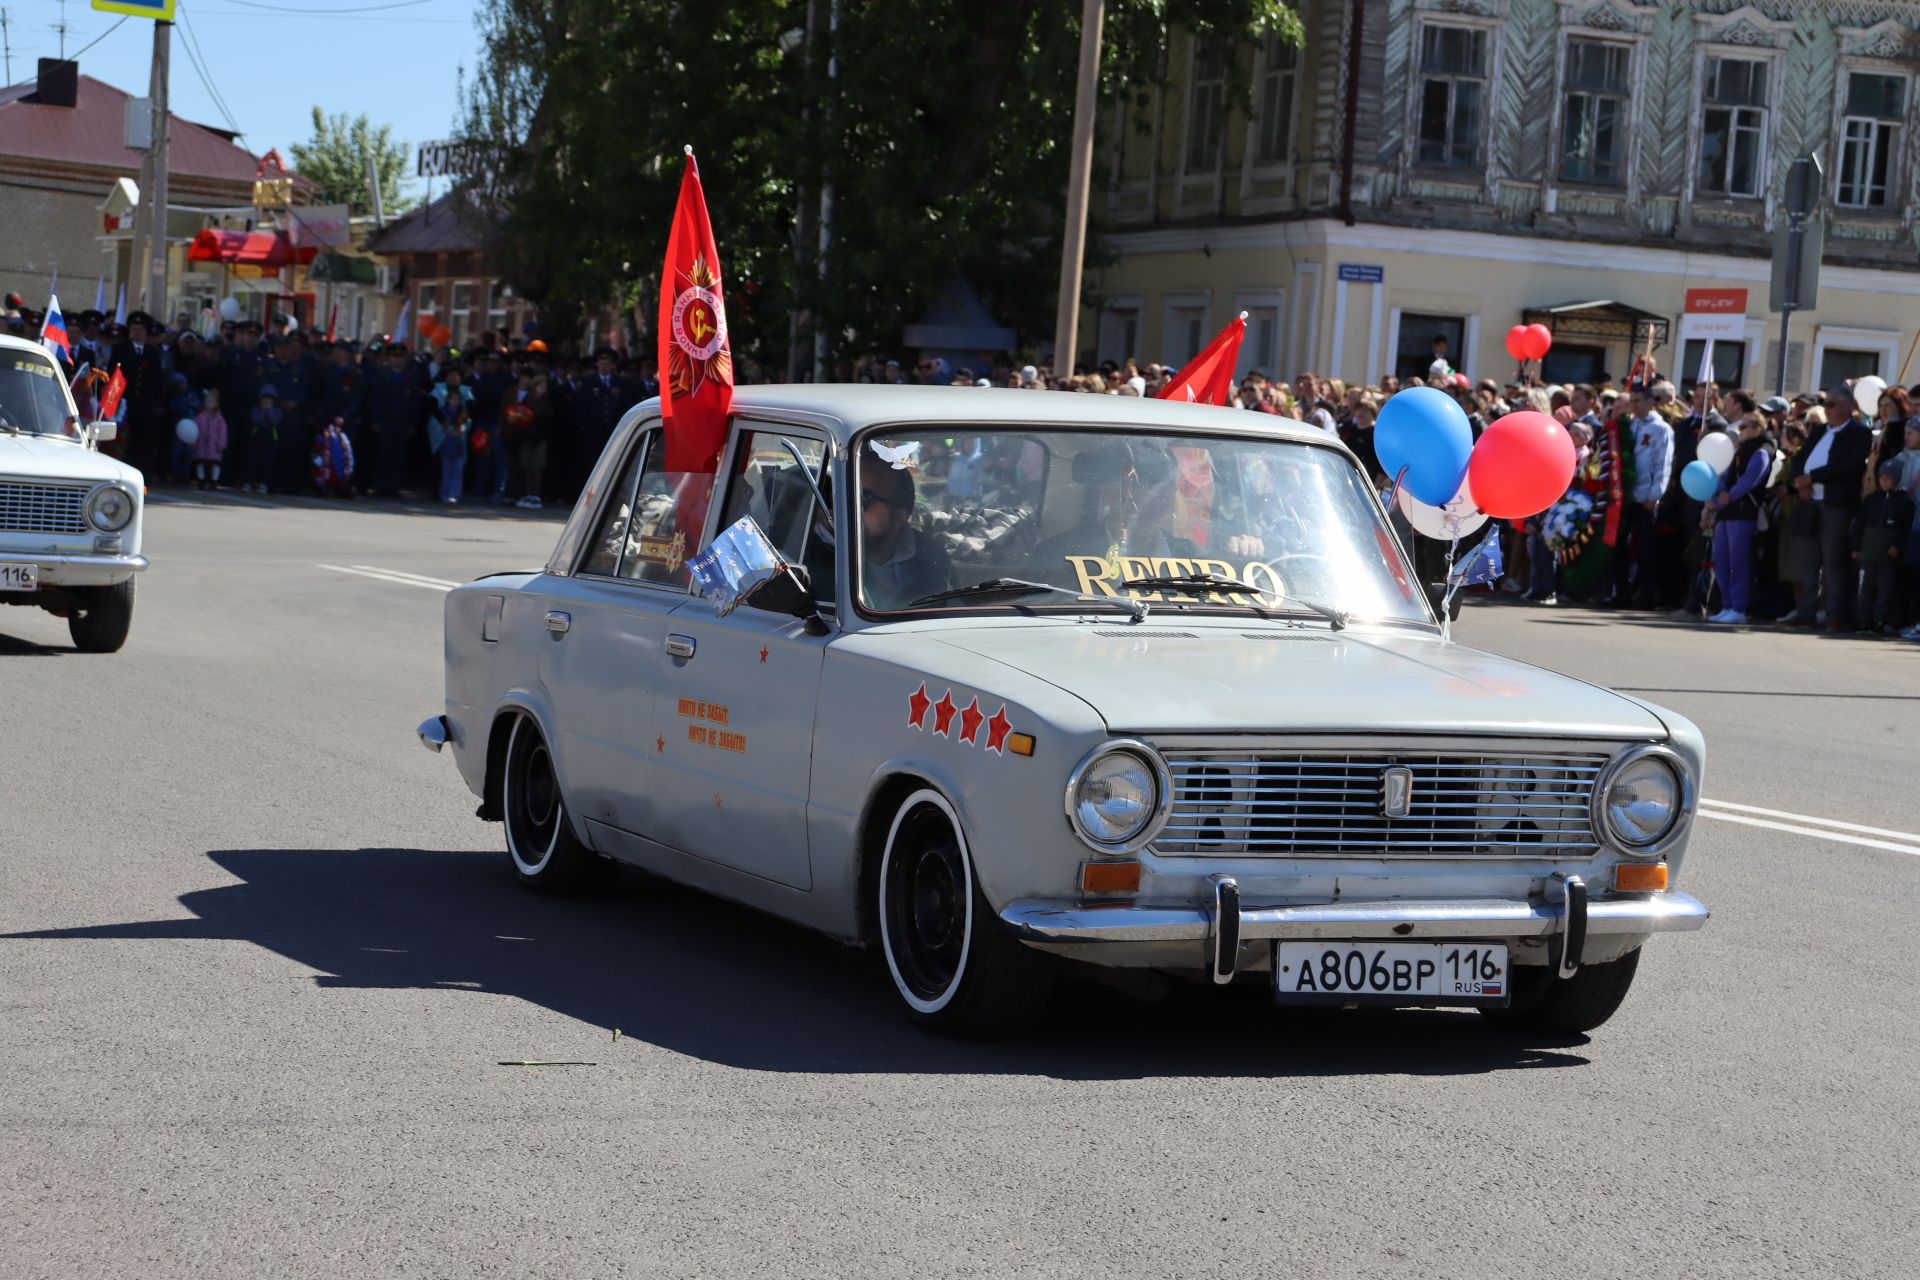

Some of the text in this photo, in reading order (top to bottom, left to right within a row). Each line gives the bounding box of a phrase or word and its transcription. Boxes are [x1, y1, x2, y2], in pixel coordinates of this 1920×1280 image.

[2, 567, 30, 582] 116
[1065, 555, 1286, 608] RETRO
[698, 701, 705, 719] НЕ
[688, 724, 707, 744] НИЧТО
[708, 729, 717, 748] НЕ
[1296, 950, 1496, 991] А806ВР 116
[1455, 982, 1481, 993] RUS
